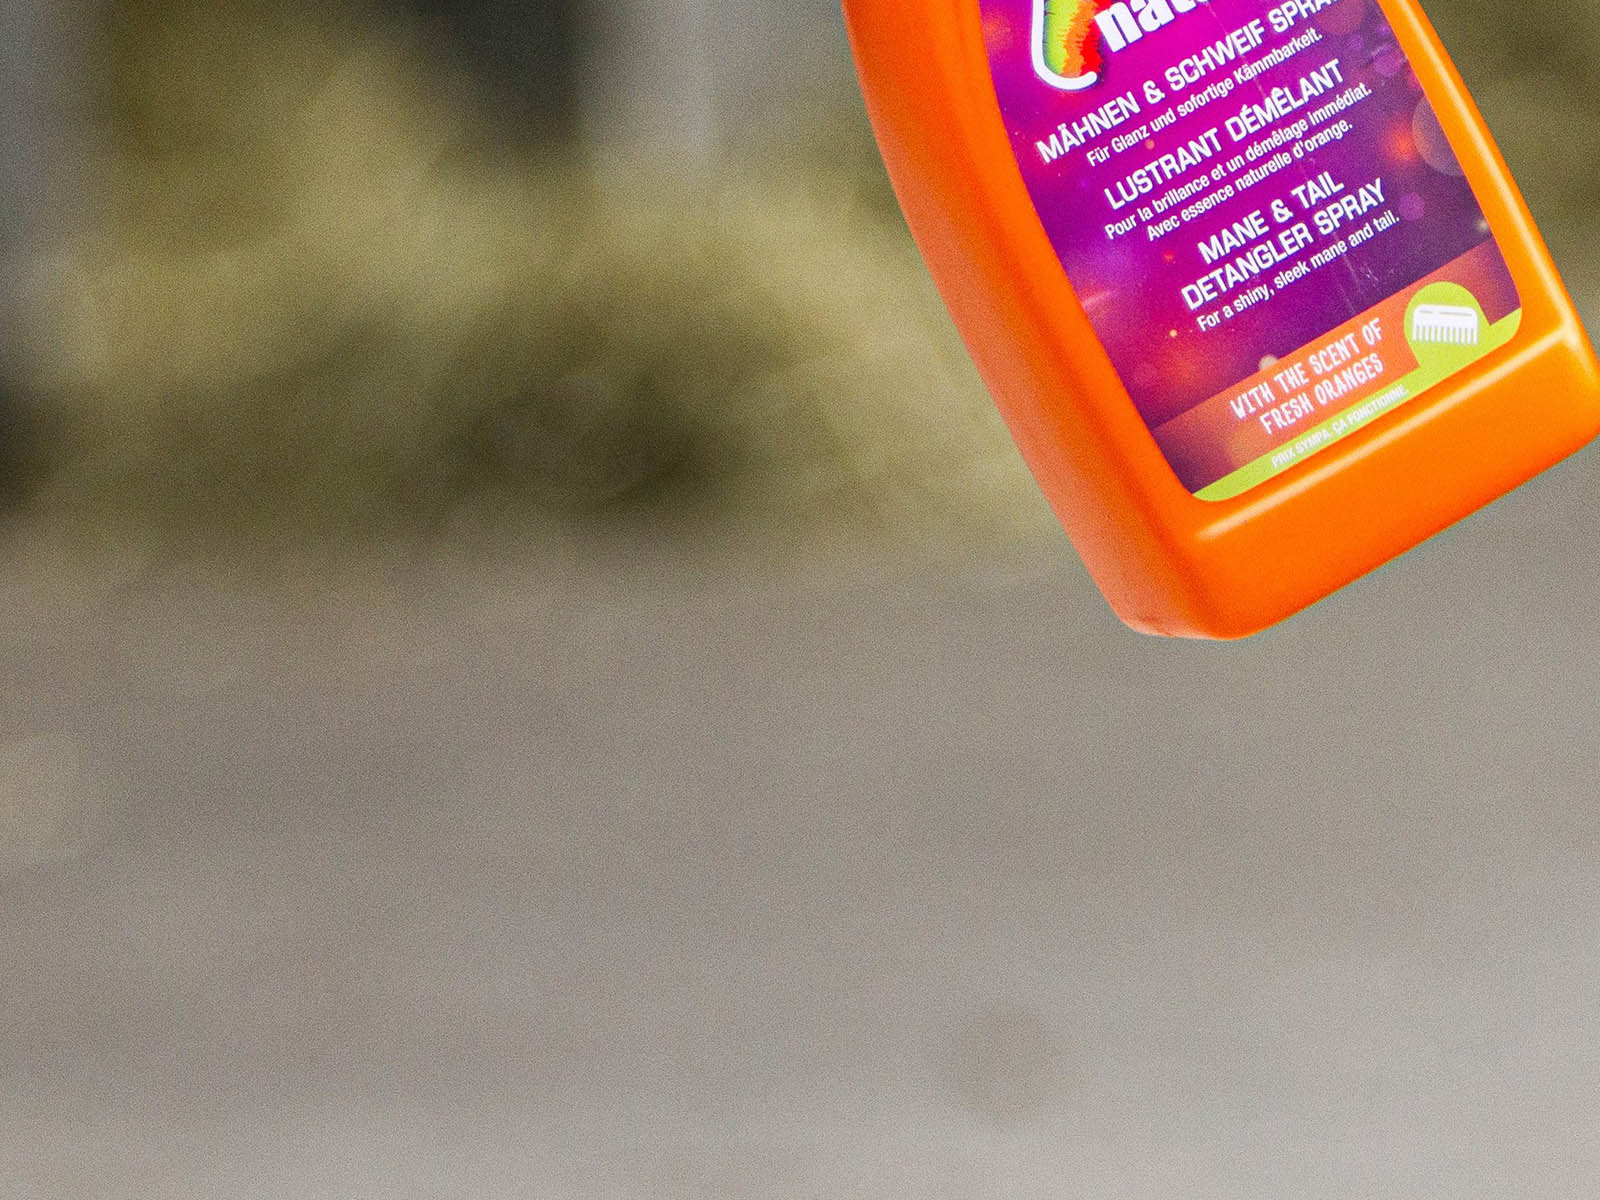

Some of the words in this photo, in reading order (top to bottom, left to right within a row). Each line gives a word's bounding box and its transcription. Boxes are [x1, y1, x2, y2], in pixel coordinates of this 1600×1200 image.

[1036, 91, 1141, 163] MÄHNEN
[1143, 80, 1165, 104] &
[1165, 19, 1264, 91] SCHWEIF
[1087, 146, 1110, 167] Für
[1111, 125, 1150, 153] Glanz
[1150, 107, 1177, 132] und
[1178, 77, 1234, 117] sofortige
[1233, 27, 1323, 85] Kämmbarkeit.
[1104, 128, 1222, 209] LUSTRANT
[1225, 58, 1343, 142] DÉMÊLANT
[1105, 215, 1137, 239] Pour
[1137, 207, 1154, 222] la
[1152, 175, 1210, 213] brillance
[1211, 163, 1227, 180] et
[1226, 157, 1246, 172] un
[1245, 118, 1309, 162] démêlage
[1308, 82, 1372, 126] immédiat.
[1148, 215, 1180, 242] Avec
[1181, 185, 1235, 222] essence
[1235, 151, 1292, 192] naturelle
[1293, 119, 1353, 159] d'orange.
[1198, 210, 1269, 264] MANE
[1271, 199, 1293, 223] &
[1291, 171, 1345, 208] TAIL
[1181, 223, 1314, 310] DETANGLER
[1314, 178, 1385, 235] SPRAY
[1197, 314, 1221, 332] For
[1223, 306, 1234, 318] a
[1234, 284, 1275, 312] shiny,
[1273, 261, 1310, 289] sleek
[1310, 240, 1347, 268] mane
[1348, 224, 1374, 246] and
[1373, 210, 1399, 232] tail.
[1230, 381, 1275, 420] WITH
[1274, 363, 1309, 394] THE
[1308, 333, 1360, 375] SCENT
[1362, 317, 1382, 346] OF
[1259, 392, 1314, 435] FRESH
[1314, 353, 1384, 405] ORANGES
